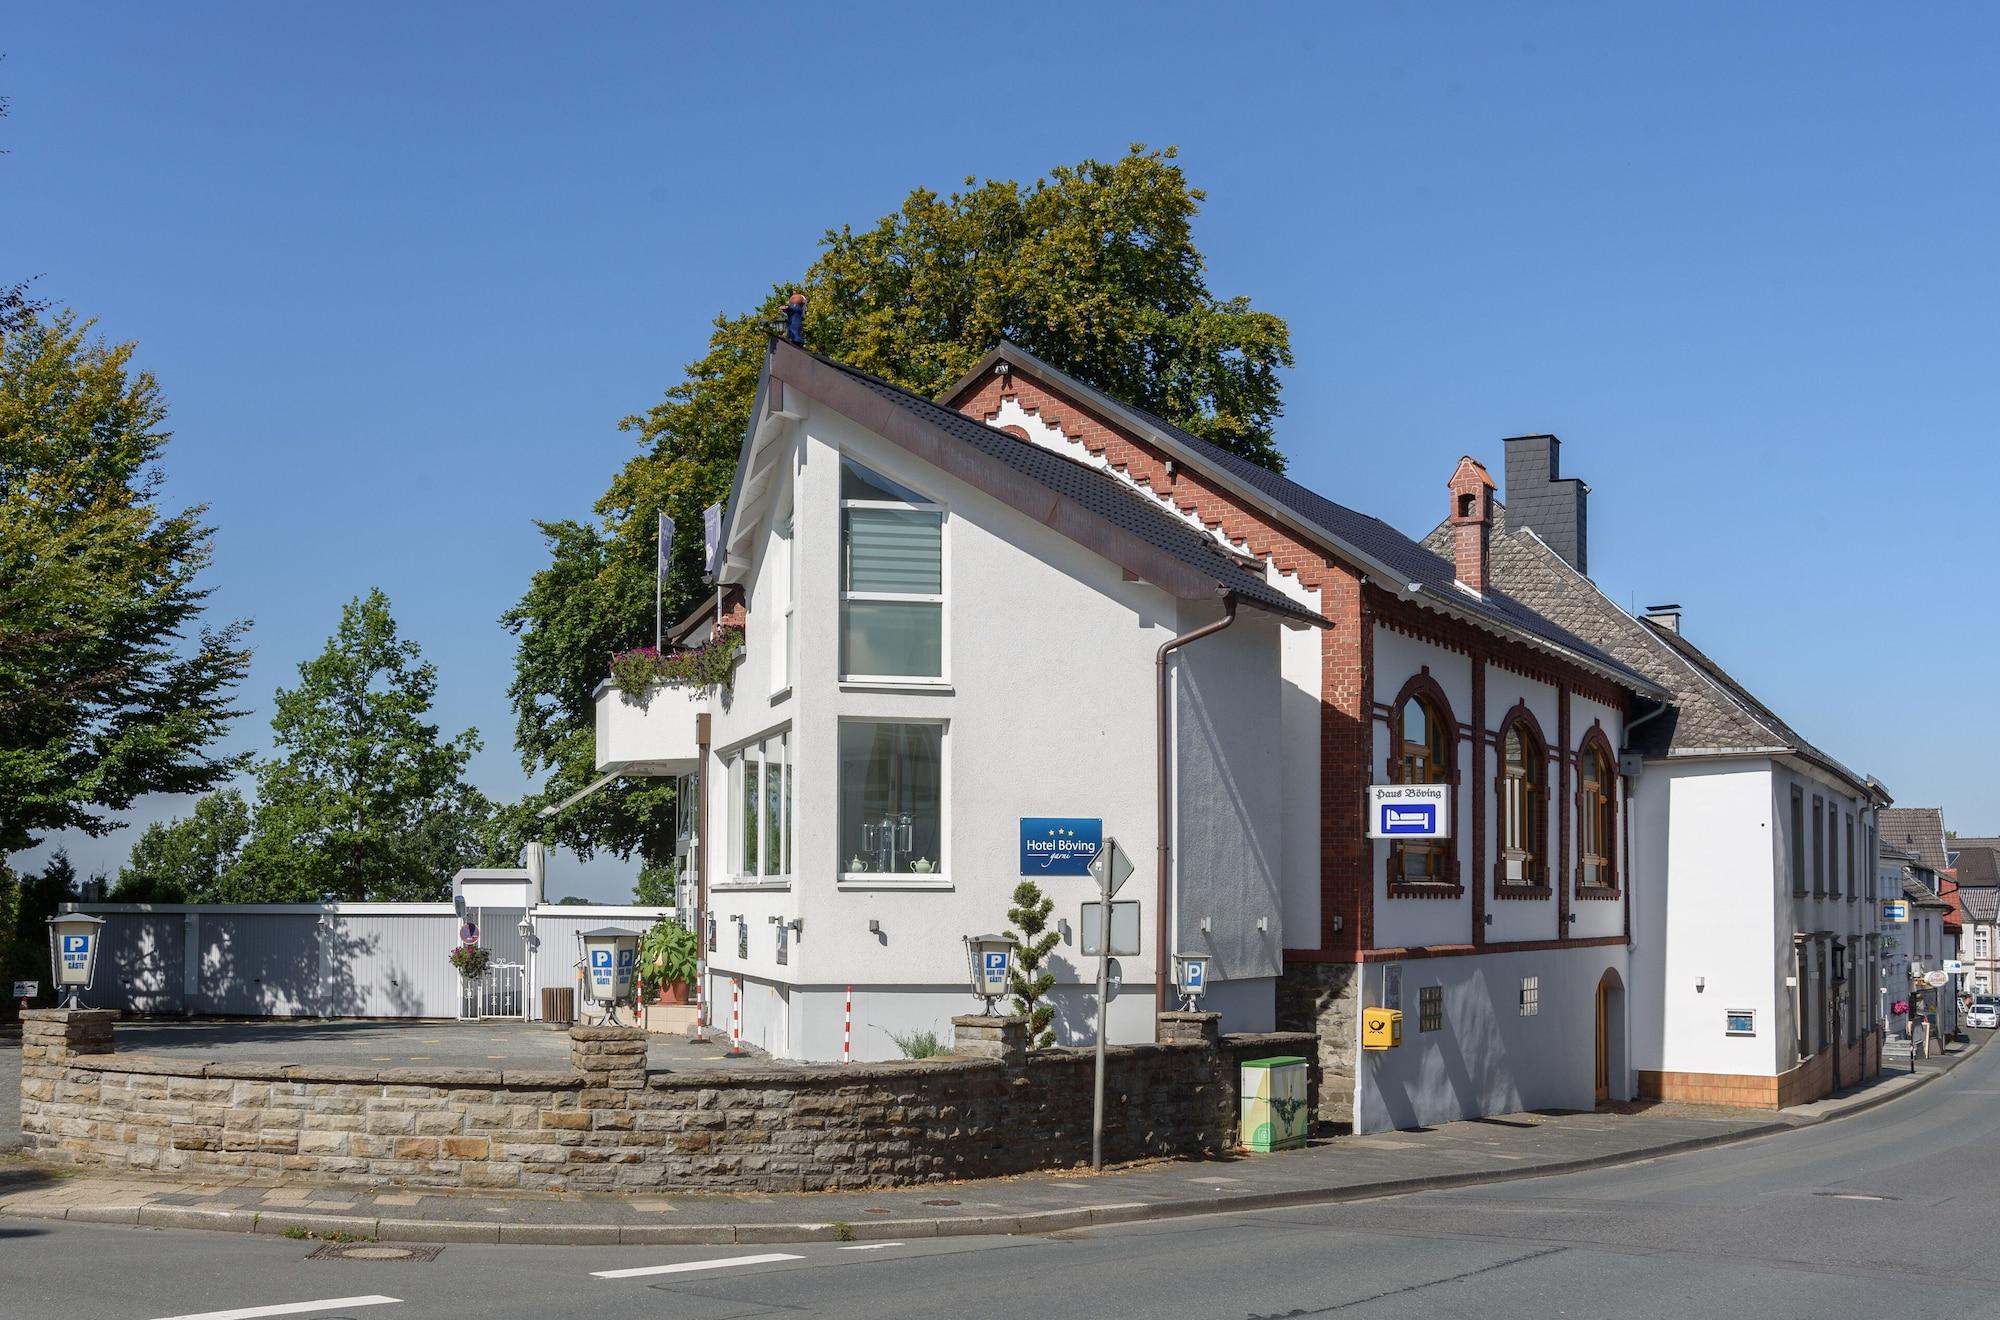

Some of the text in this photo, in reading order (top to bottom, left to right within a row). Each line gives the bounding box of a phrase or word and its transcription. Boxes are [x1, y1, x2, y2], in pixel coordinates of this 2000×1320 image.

[1376, 788, 1442, 799] Haus Böving
[1027, 840, 1095, 853] Hotel Böving
[1040, 852, 1071, 868] garni
[69, 937, 84, 952] P
[596, 951, 608, 967] P
[622, 951, 630, 966] P
[990, 955, 1003, 968] P
[1188, 964, 1201, 983] P
